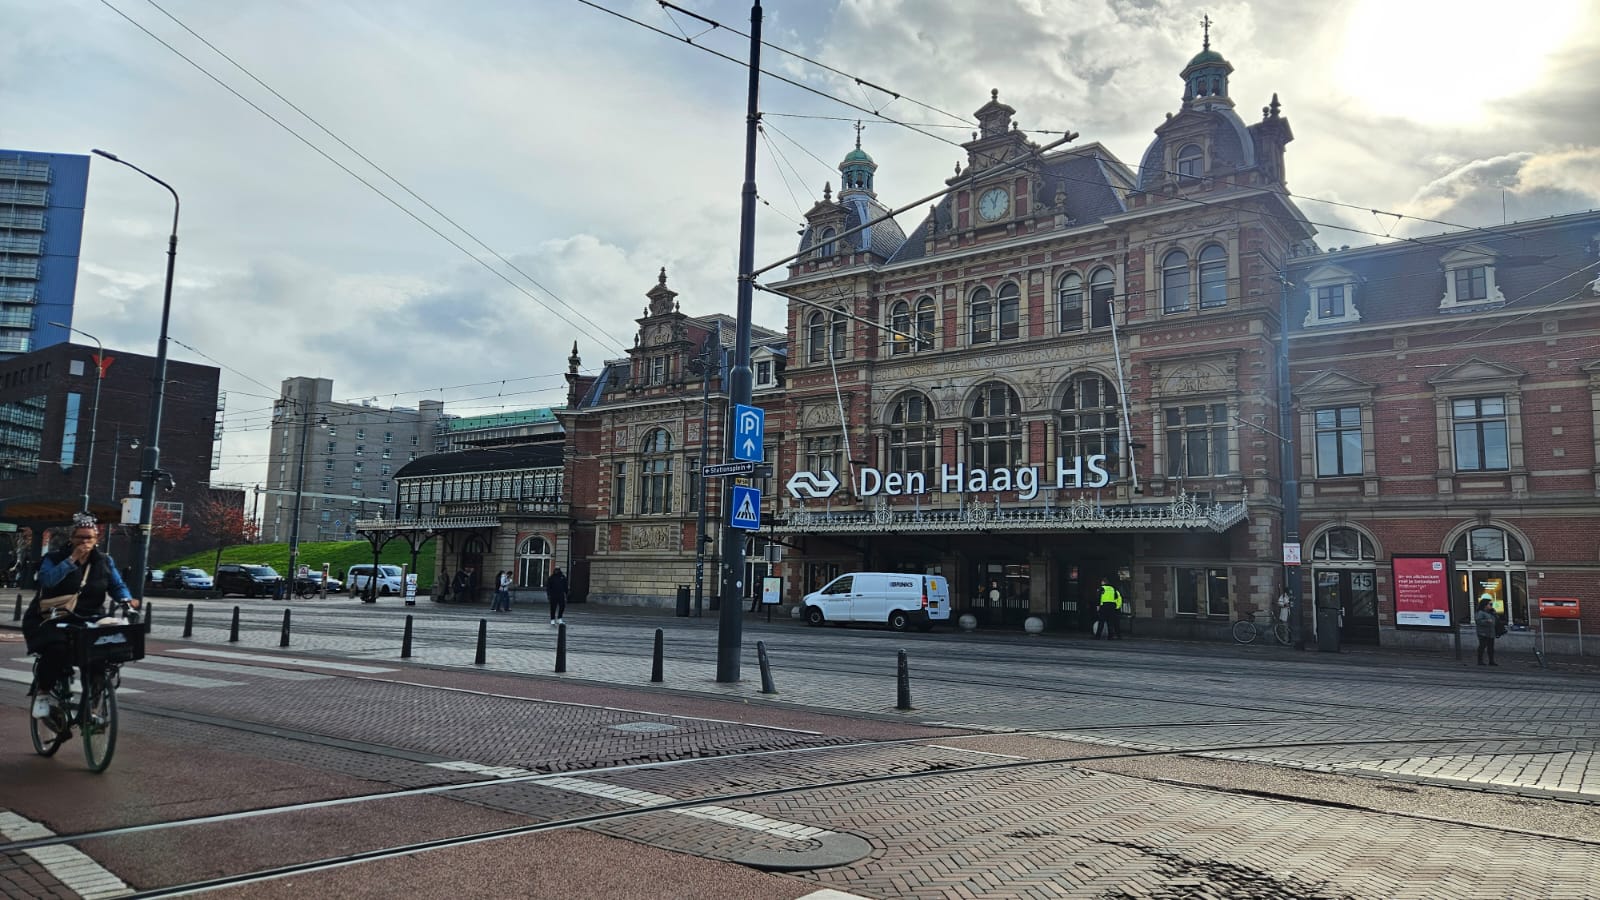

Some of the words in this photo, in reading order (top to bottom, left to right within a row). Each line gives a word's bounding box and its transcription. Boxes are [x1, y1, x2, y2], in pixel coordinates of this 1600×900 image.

[745, 417, 755, 435] P
[710, 465, 746, 474] Stationsplein
[861, 467, 926, 496] Den
[941, 462, 1039, 500] Haag
[1056, 454, 1110, 488] HS
[1353, 575, 1372, 588] 45
